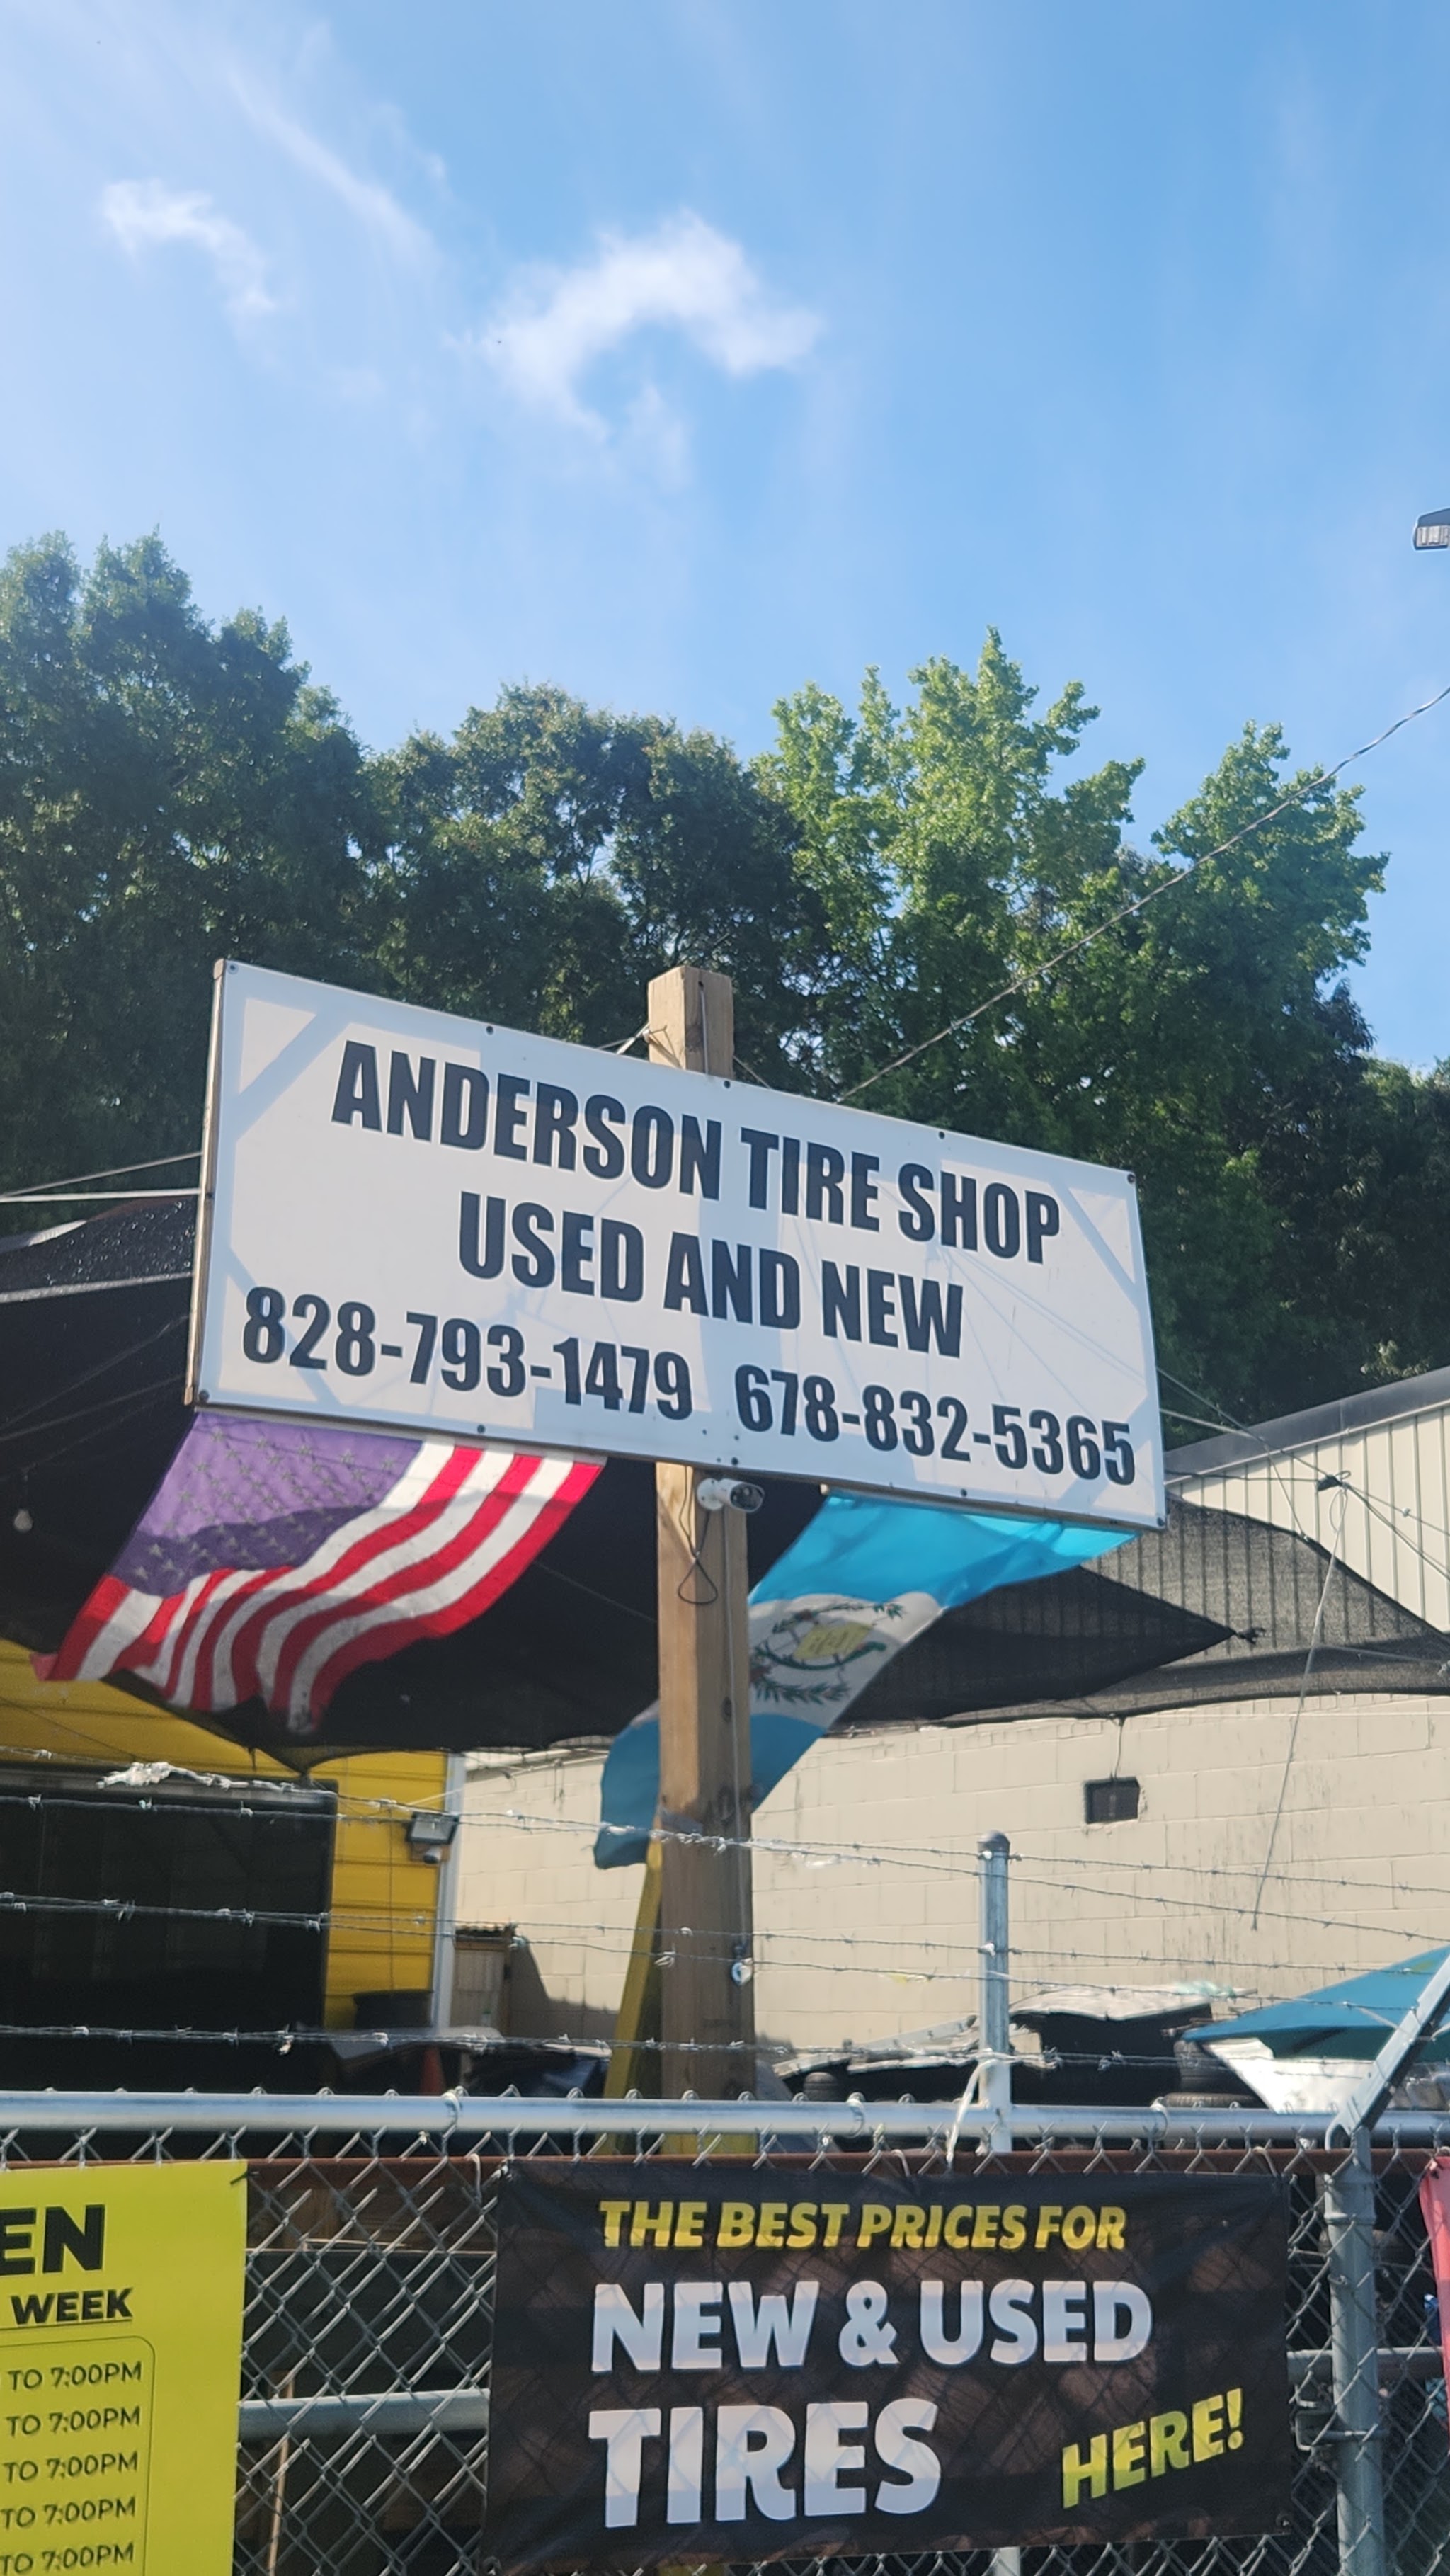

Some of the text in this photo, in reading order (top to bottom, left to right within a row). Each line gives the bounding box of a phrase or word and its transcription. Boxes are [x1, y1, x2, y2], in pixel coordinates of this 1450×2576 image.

[331, 1039, 1061, 1265] ANDERSON TIRE SHOP
[459, 1190, 964, 1359] USED AND NEW
[242, 1286, 1135, 1486] 828-793-1479 678-832-5365
[599, 2201, 1127, 2251] THE BEST PRICES FOR
[10, 2286, 134, 2325] WEEK
[591, 2279, 1153, 2373] NEW & USED
[8, 2361, 142, 2390] TO 7:00PM
[6, 2406, 140, 2436] TO 7:00PM
[2, 2451, 138, 2483] TO 7:00PM
[588, 2397, 942, 2528] TIRES
[1062, 2388, 1244, 2509] HERE!
[0, 2496, 136, 2530] TO 7:00PM
[0, 2541, 134, 2576] TO 7:00PM
